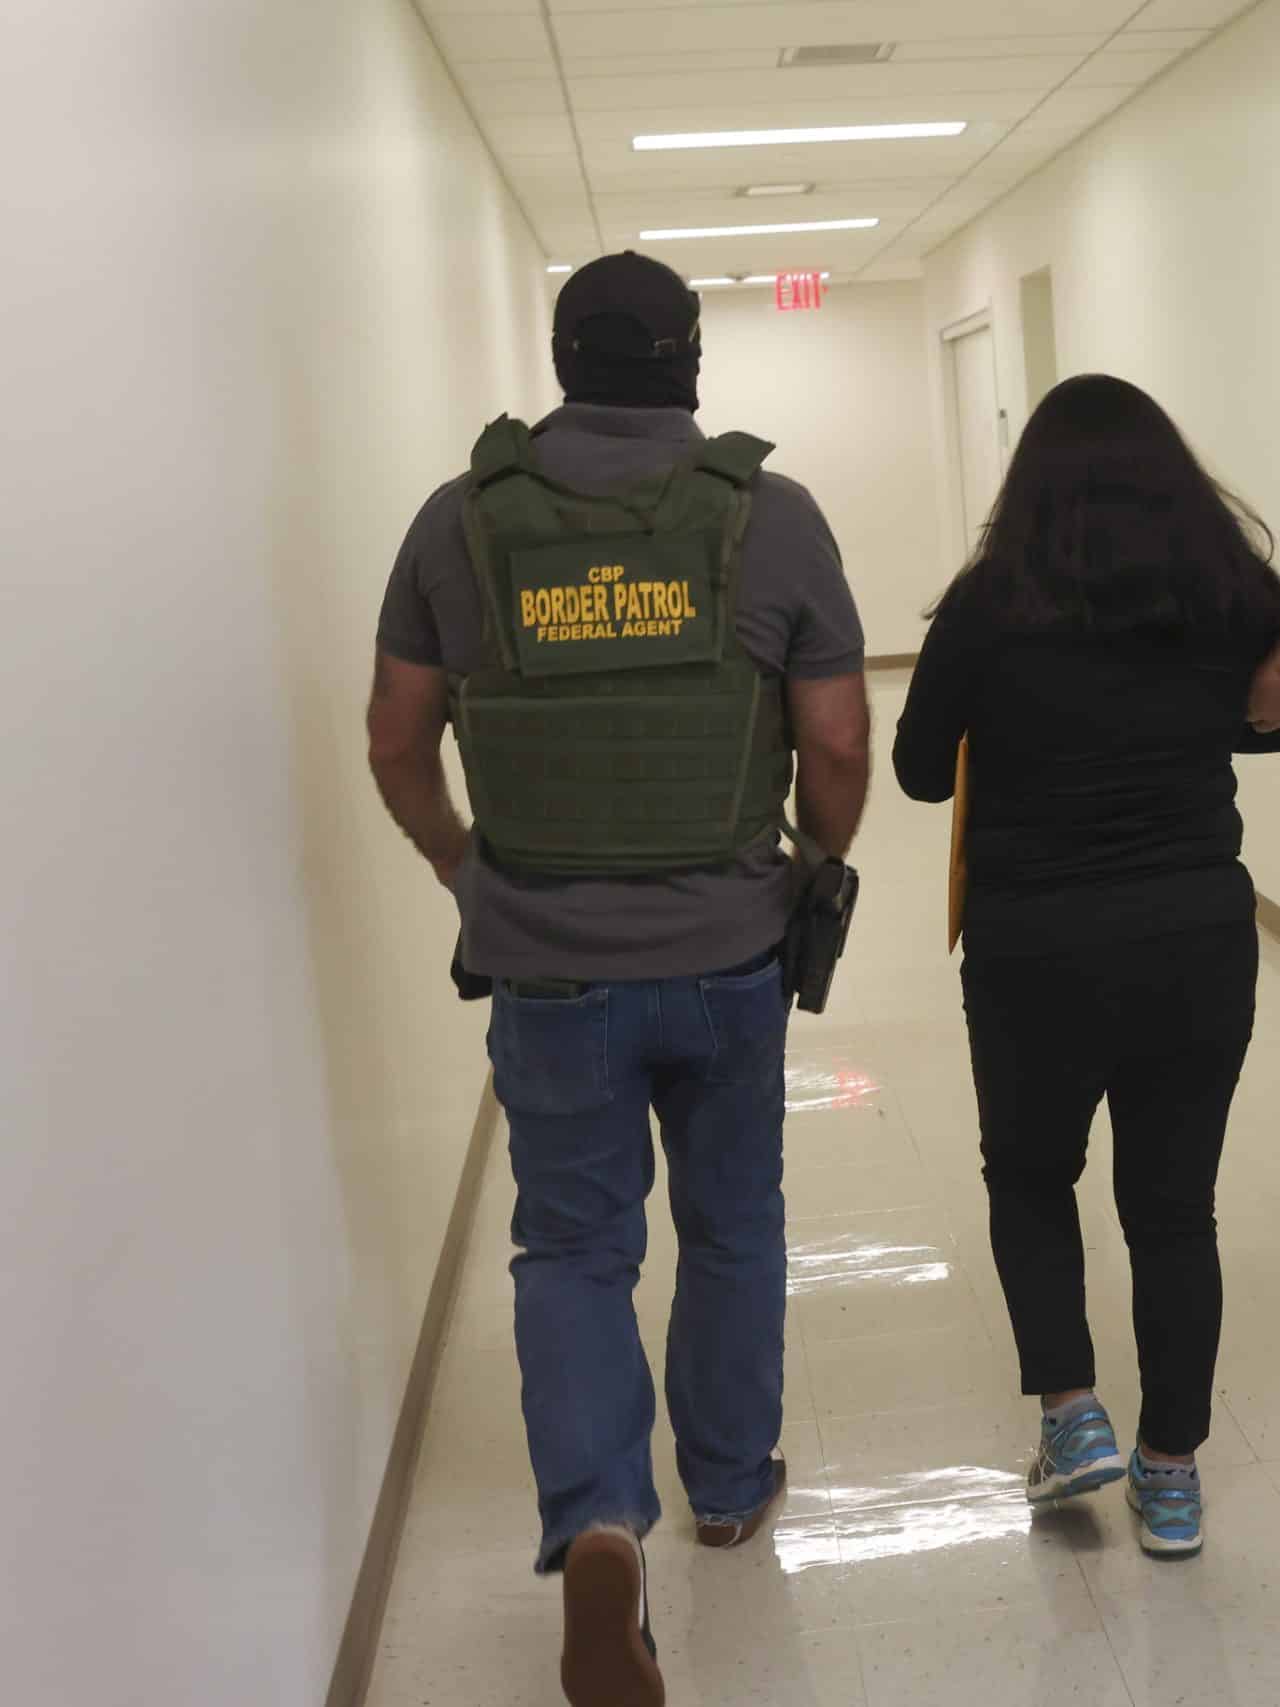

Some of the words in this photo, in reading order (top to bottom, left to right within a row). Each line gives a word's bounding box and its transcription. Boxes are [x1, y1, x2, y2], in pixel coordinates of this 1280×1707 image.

[776, 273, 825, 311] EXIT
[588, 565, 625, 583] CBP
[520, 584, 610, 627] BORDER
[614, 580, 696, 621] PATROL
[537, 622, 617, 643] FEDERAL
[621, 619, 684, 637] AGENT
